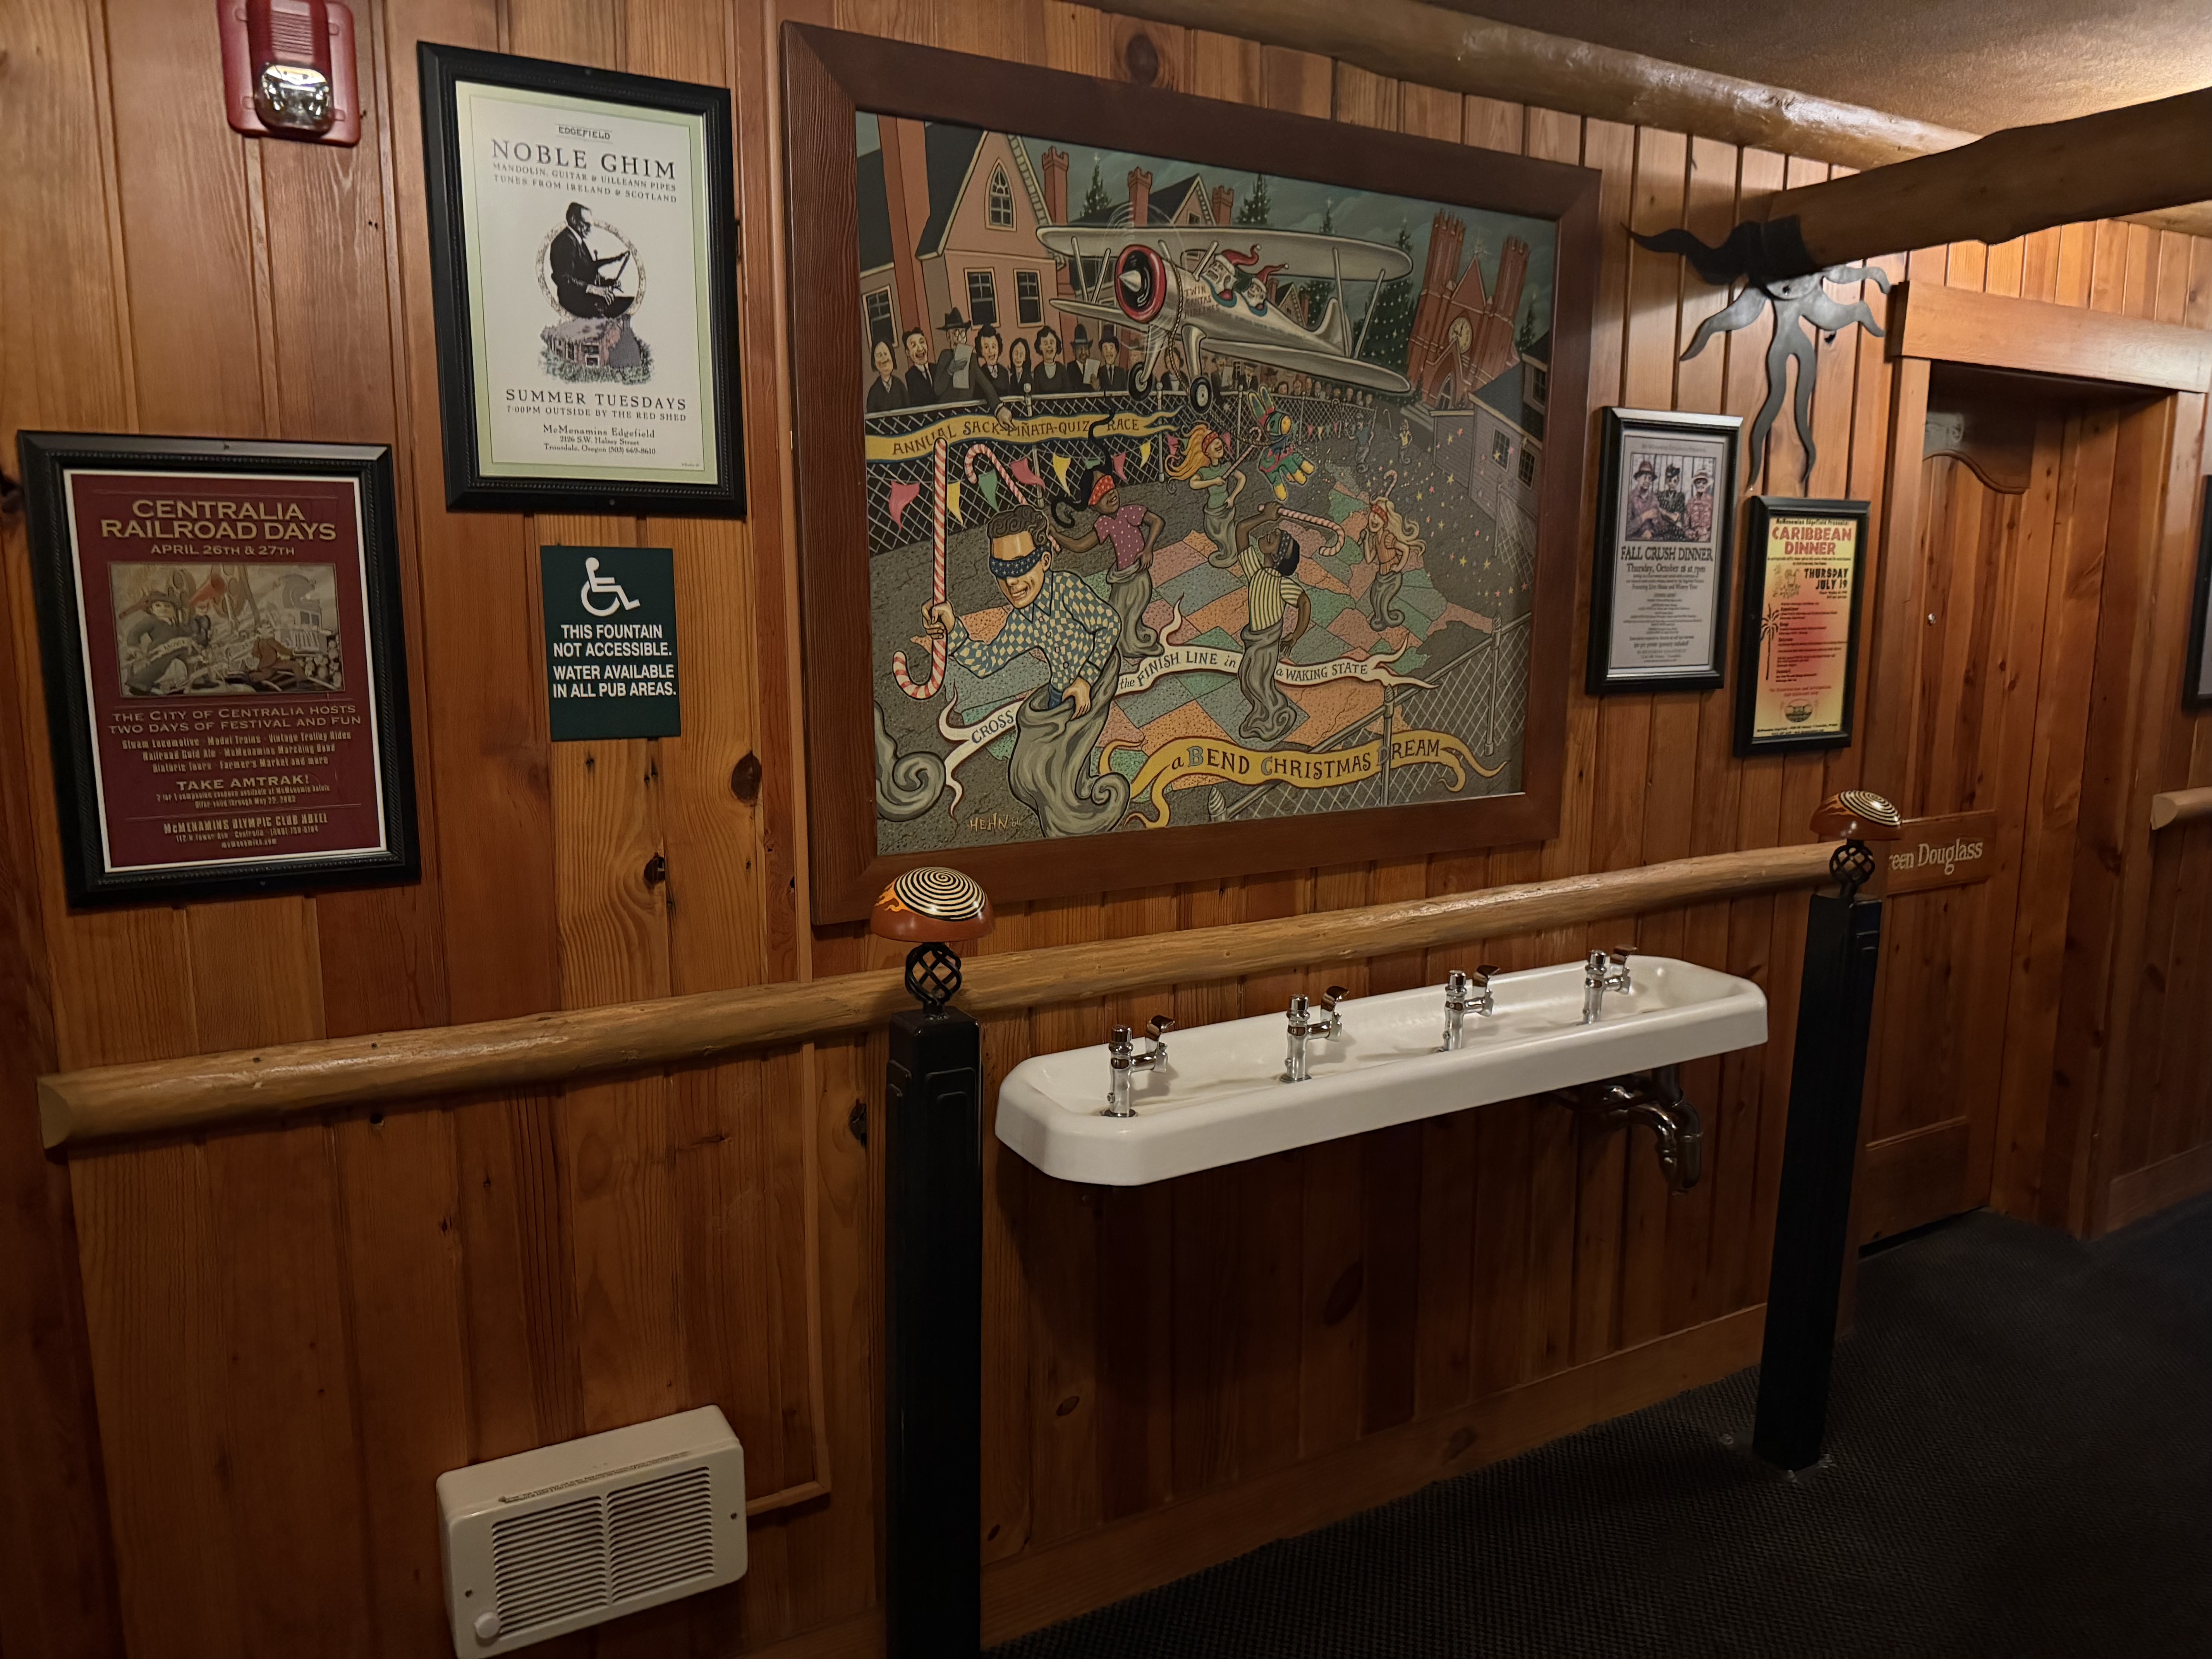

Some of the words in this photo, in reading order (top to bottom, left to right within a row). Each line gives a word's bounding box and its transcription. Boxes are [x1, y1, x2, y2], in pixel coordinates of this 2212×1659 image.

[558, 126, 610, 140] EDGEFIELD
[491, 138, 587, 169] NOBLE
[601, 153, 675, 180] GHIM
[494, 174, 527, 185] TUNES
[532, 178, 561, 189] FROM
[567, 182, 610, 195] IRELAND
[625, 189, 677, 203] SCOTLAND
[552, 169, 587, 181] GUITAR
[651, 181, 676, 192] PIPES
[506, 389, 586, 405] SUMMER
[595, 393, 686, 411] TUESDAYS
[545, 407, 591, 417] OUTSIDE
[595, 409, 607, 417] BY
[613, 410, 632, 419] THE
[636, 412, 656, 420] RED
[660, 413, 686, 422] SHED
[543, 424, 607, 436] McMenamins
[612, 427, 654, 438] Edgefield
[892, 425, 957, 455] ANNUAL
[1107, 419, 1139, 431] RACE
[582, 445, 606, 453] Oregon
[595, 437, 617, 445] Halsey
[132, 499, 306, 521] CENTRALIA
[101, 519, 258, 540] RAILROAD
[264, 522, 337, 541] DAYS
[1772, 526, 1852, 541] CARIBBEAN
[150, 544, 199, 555] APRIL
[203, 545, 240, 556] 26TH
[244, 545, 255, 555] &
[258, 545, 295, 556] 27TH
[1621, 546, 1643, 560] FALL
[1645, 546, 1676, 561] CRUSH
[1678, 547, 1713, 562] DINNER
[1784, 541, 1836, 555] DINNER
[1656, 563, 1678, 572] October
[1804, 568, 1848, 579] THURSDAY
[1815, 579, 1836, 589] JULY
[1839, 579, 1847, 589] 19
[560, 624, 592, 639] THIS
[596, 624, 663, 639] FOUNTAIN
[553, 642, 582, 658] NOT
[585, 642, 672, 657] ACCESSIBLE.
[553, 665, 601, 680] WATER
[603, 664, 675, 680] AVAILABLE
[1120, 676, 1135, 689] the
[1137, 652, 1180, 687] FINISH
[1186, 651, 1218, 665] LINE
[1224, 655, 1236, 668] in
[1286, 666, 1328, 682] WAKING
[1332, 662, 1368, 676] STATE
[553, 683, 567, 698] IN
[570, 683, 596, 698] ALL
[599, 682, 626, 697] PUB
[630, 681, 677, 697] AREAS.
[112, 713, 144, 722] THE
[149, 710, 187, 721] CITY
[192, 710, 213, 719] OF
[218, 706, 304, 718] CENTRALIA
[310, 704, 356, 715] HOSTS
[107, 724, 144, 734] TWO
[149, 722, 189, 733] DAYS
[194, 722, 214, 731] OF
[220, 719, 291, 730] FESTIVAL
[296, 717, 326, 727] AND
[331, 715, 361, 725] FUN
[972, 710, 1014, 744] CROSS
[121, 739, 149, 750] Steam
[151, 737, 200, 749] Locomotive
[235, 734, 261, 744] Trains
[268, 733, 299, 744] Vintage
[300, 731, 327, 742] Trolley
[142, 750, 179, 761] Railroad
[224, 746, 276, 757] McMenamins
[277, 743, 314, 755] Marching
[1171, 756, 1184, 770] a
[1187, 745, 1250, 775] BEND
[1261, 752, 1371, 780] CHRISTMAS
[1376, 739, 1440, 766] DREAM
[259, 757, 289, 767] Market
[291, 756, 306, 766] and
[307, 756, 329, 766] more
[175, 779, 224, 791] TAKE
[230, 774, 309, 788] AMTRAK!
[163, 819, 230, 834] McMENAMINS
[232, 816, 272, 829] OLYMPIC
[275, 814, 298, 826] CLUB
[301, 812, 328, 824] HOTEL
[969, 812, 1009, 832] HEHN
[1917, 837, 1983, 875] Douglass
